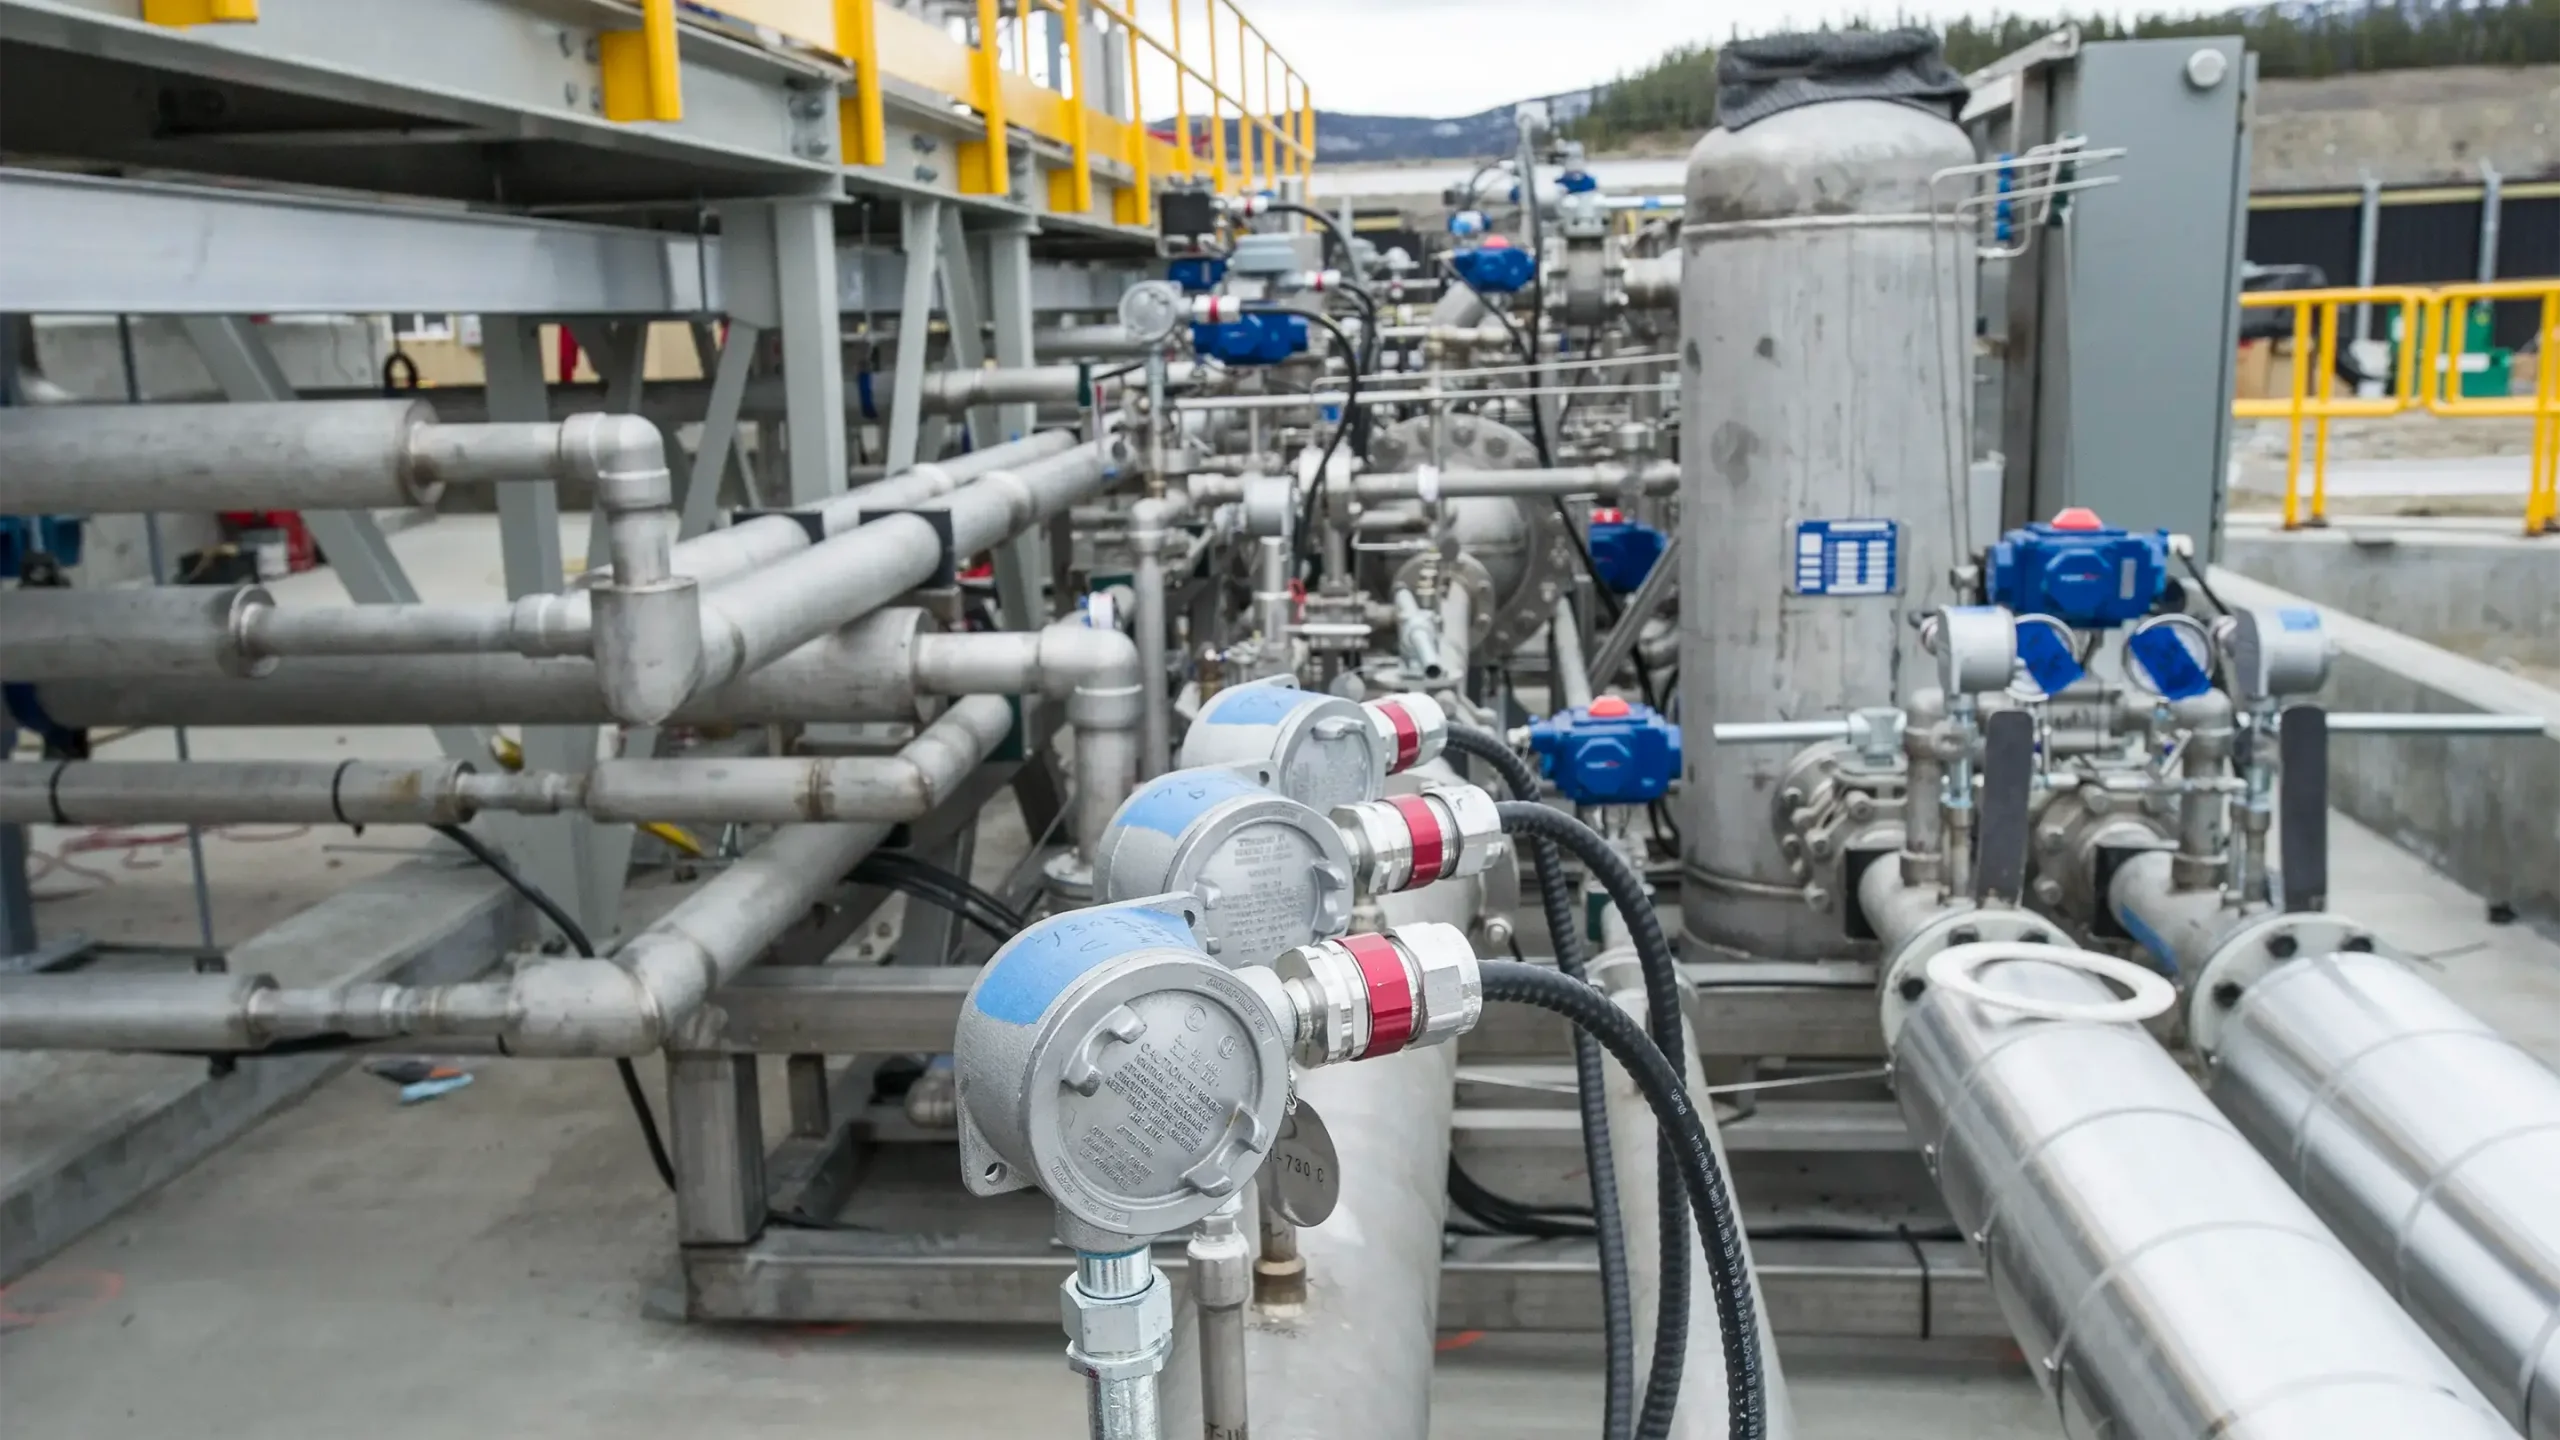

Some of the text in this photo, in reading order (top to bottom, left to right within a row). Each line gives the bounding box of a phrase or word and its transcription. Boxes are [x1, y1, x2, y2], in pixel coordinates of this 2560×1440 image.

[1103, 1075, 1128, 1097] KEEP
[1124, 1092, 1148, 1114] TIGHT
[1145, 1110, 1169, 1131] WHEN
[1112, 1068, 1150, 1101] CIRCUITS
[1147, 1096, 1177, 1123] BEFORE
[1132, 1053, 1215, 1123] IGNITION OF HAZARDOUS
[1193, 1087, 1224, 1114] PREVENT
[1126, 1109, 1145, 1127] ARE
[1168, 1098, 1211, 1136] DISCONNECT
[1264, 1148, 1310, 1177] T-730
